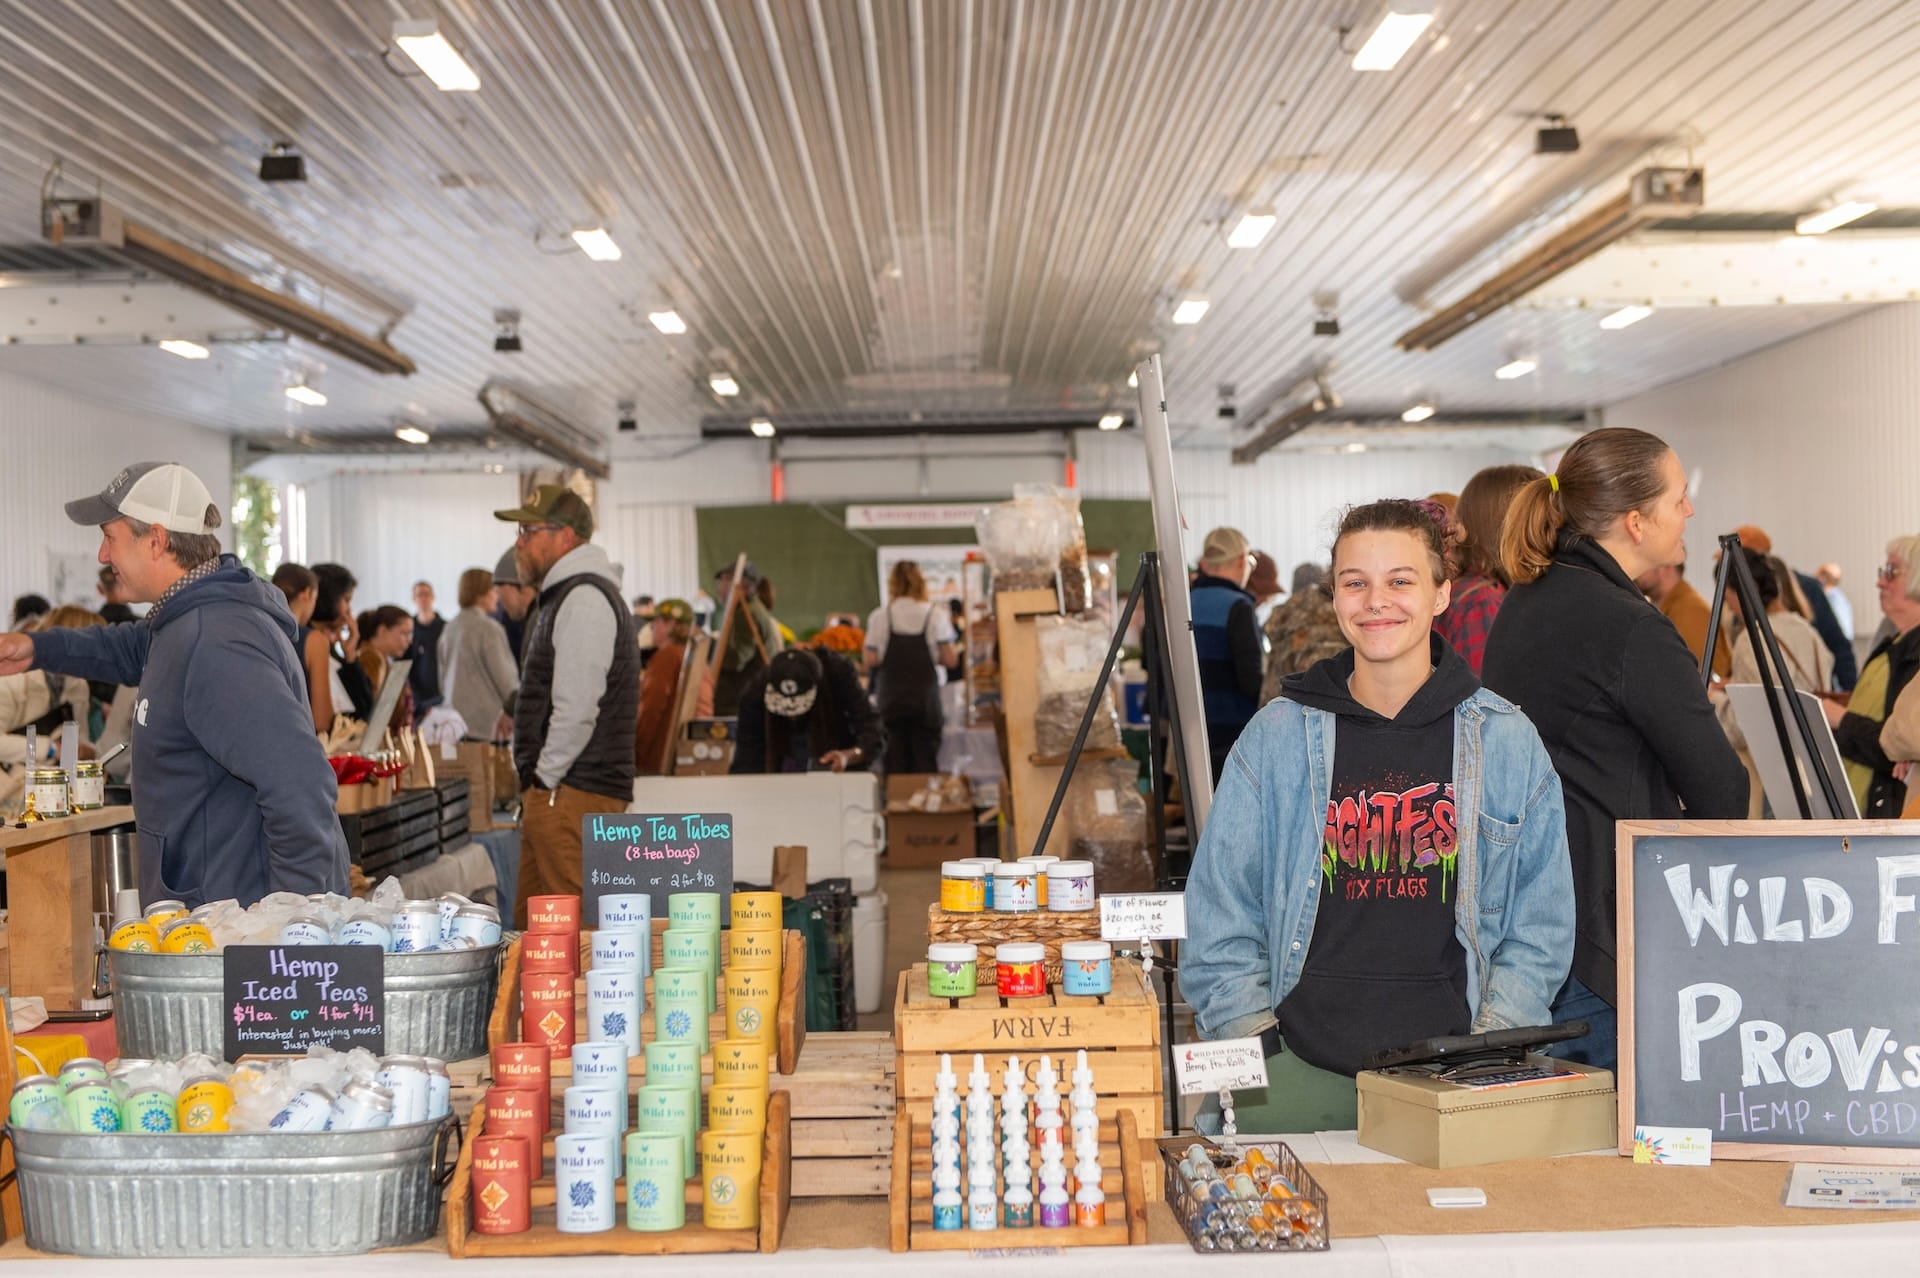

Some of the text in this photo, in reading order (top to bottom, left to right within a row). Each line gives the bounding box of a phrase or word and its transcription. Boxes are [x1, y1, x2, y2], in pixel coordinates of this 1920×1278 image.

[592, 814, 731, 844] Hemp Tea Tubes
[625, 843, 701, 865] (8 tea bags)
[591, 868, 715, 888] $10 each or 2 for $18
[1345, 877, 1428, 900] SIX FLAGS
[1126, 897, 1135, 906] of
[1139, 898, 1168, 907] Flower
[531, 913, 571, 923] Wild Fox
[605, 913, 644, 921] Wild Fox
[673, 911, 712, 920] Wild Fox
[733, 910, 772, 919] Wild Fox
[526, 950, 566, 960] Wild Fox
[595, 950, 635, 959] Wild Fox
[670, 949, 709, 958] Wild Fox
[733, 947, 772, 956] Wild Fox
[270, 948, 339, 984] Hemp
[242, 980, 368, 1002] Iced Teas
[531, 990, 572, 1000] Wild Fox
[594, 990, 634, 999] Wild Fox
[658, 988, 698, 997] Wild Fox
[729, 988, 769, 997] Wild Fox
[290, 1009, 309, 1021] or
[318, 1006, 329, 1021] 4
[330, 1007, 350, 1021] for
[352, 1002, 374, 1022] $14
[992, 1016, 1073, 1039] FARM
[237, 1025, 383, 1043] Interested in buying more?
[281, 1040, 308, 1050] Just
[1245, 1047, 1260, 1060] CBD
[499, 1063, 541, 1074] Wild Fox
[576, 1063, 617, 1073] Wild Fox
[652, 1062, 694, 1071] Wild Fox
[717, 1061, 759, 1071] Wild Fox
[1185, 1056, 1246, 1073] Hemp Pre-Rolls
[490, 1108, 533, 1119] Wild Fox
[569, 1109, 612, 1119] Wild Fox
[642, 1108, 685, 1117] Wild Fox
[712, 1106, 753, 1116] Wild Fox
[1719, 1091, 1811, 1134] HEMP
[1847, 1100, 1917, 1137] CBD
[1690, 1143, 1705, 1151] Fox
[561, 1157, 605, 1167] Wild Fox
[628, 1157, 669, 1166] Wild Fox
[704, 1154, 745, 1164] Wild Fox
[474, 1159, 519, 1170] Wild Fox
